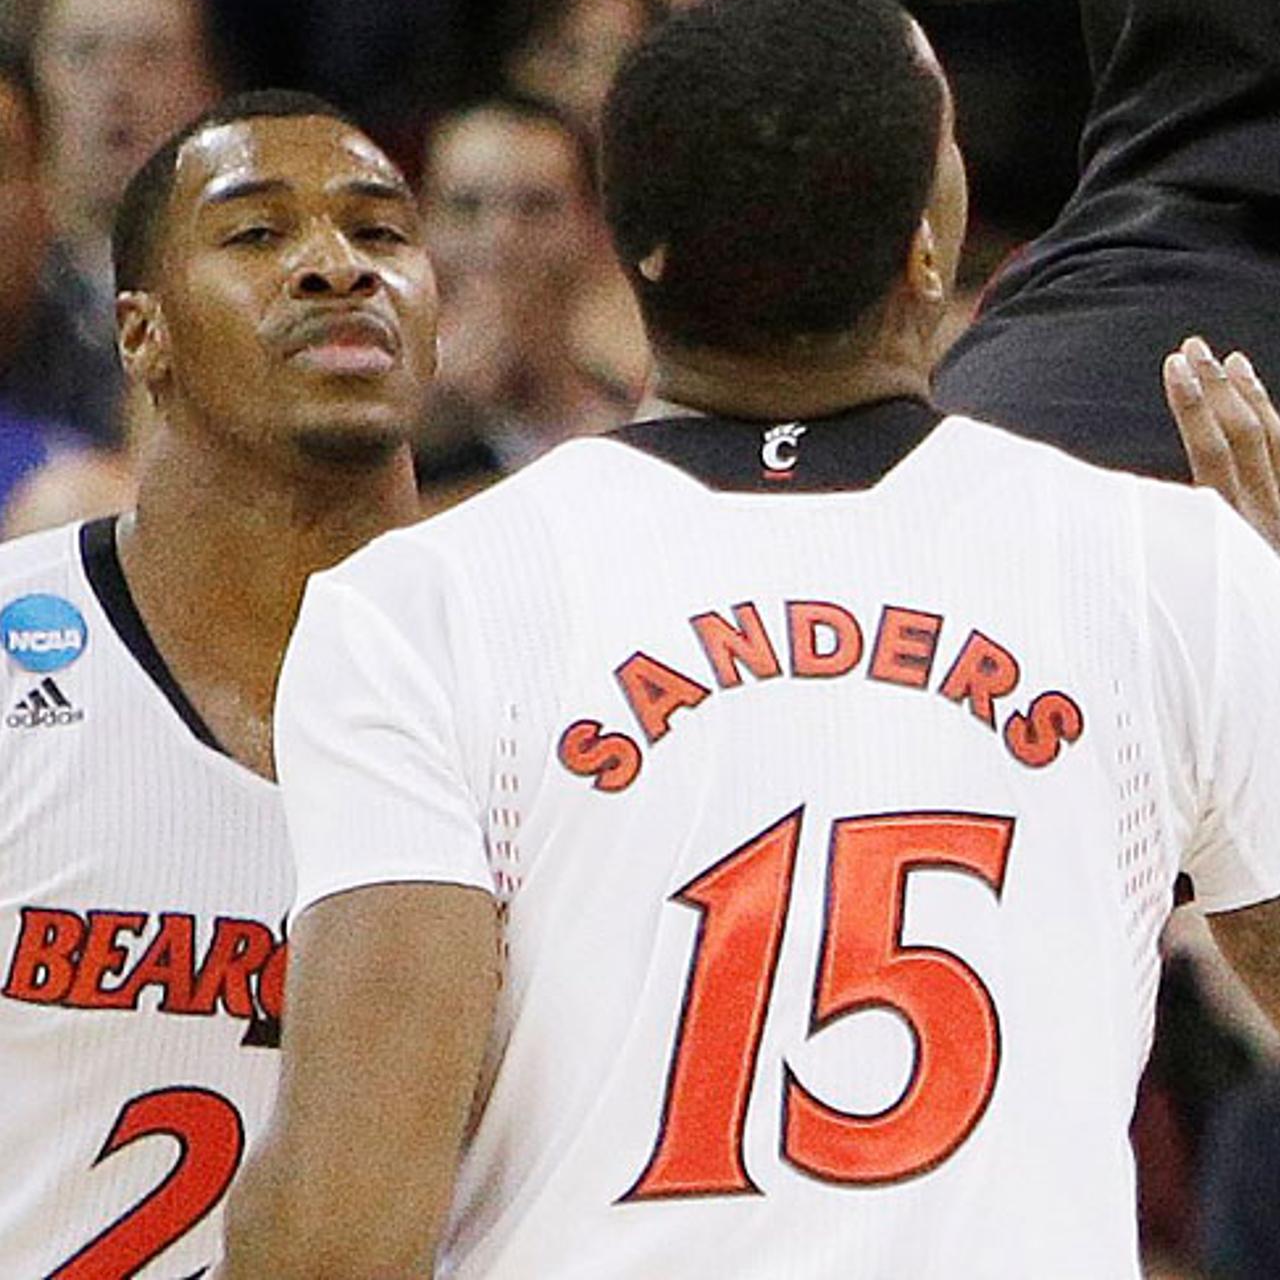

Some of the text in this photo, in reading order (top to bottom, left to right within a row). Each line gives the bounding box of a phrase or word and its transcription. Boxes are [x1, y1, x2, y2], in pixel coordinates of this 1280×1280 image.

[9, 629, 81, 652] NCAA
[557, 600, 1085, 794] SANDERS
[612, 803, 1017, 1205] 15
[42, 1085, 245, 1280] 2
